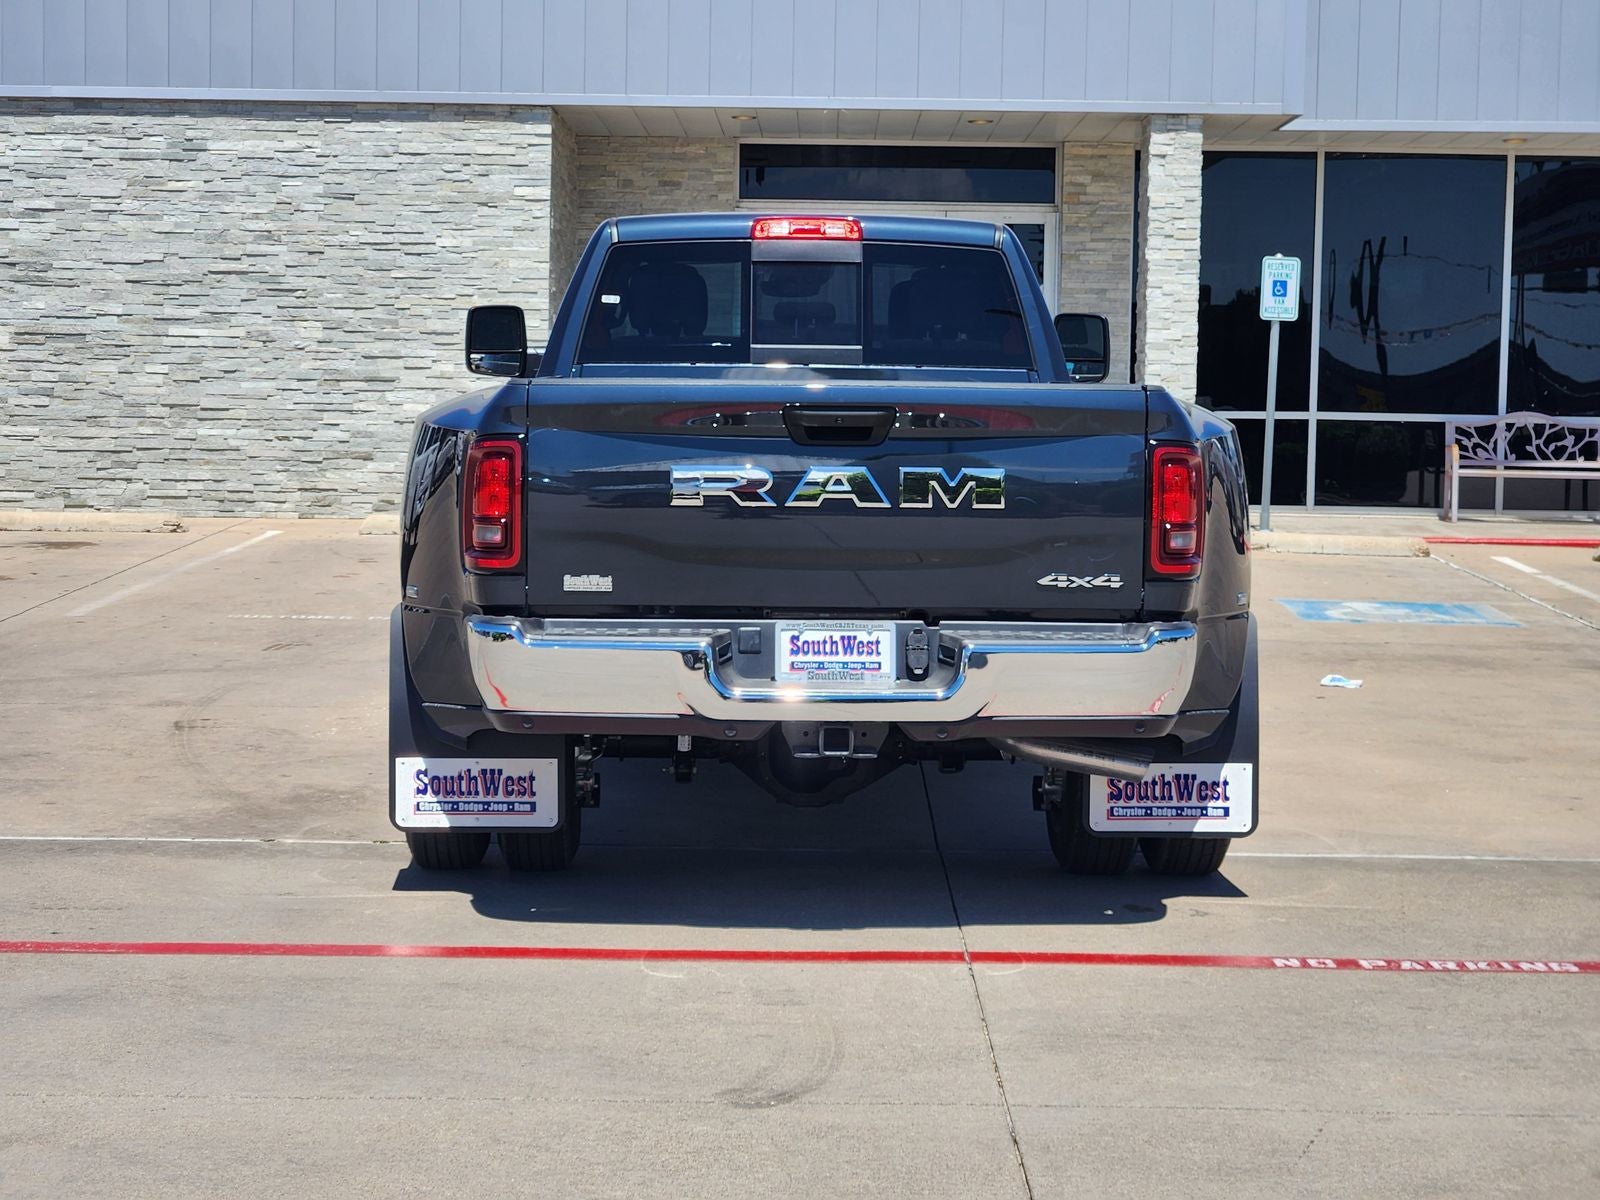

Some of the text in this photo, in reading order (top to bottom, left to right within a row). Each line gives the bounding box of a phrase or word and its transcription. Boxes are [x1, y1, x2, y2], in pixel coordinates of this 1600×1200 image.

[1267, 262, 1295, 271] RESERVED
[1269, 271, 1292, 279] PARKING
[670, 465, 1005, 509] RAM
[789, 634, 881, 657] SouthWest
[793, 661, 879, 670] Chrysler Dodge Jeep Ram
[807, 670, 865, 681] SouthWest
[414, 768, 536, 798] SouthWest
[1107, 774, 1230, 803] SouthWest
[418, 801, 531, 812] Chrysler Dodge Jeep Ram
[1113, 807, 1224, 817] Chrysler Dodge Jeep Ram
[1272, 957, 1580, 972] NO PARKING
